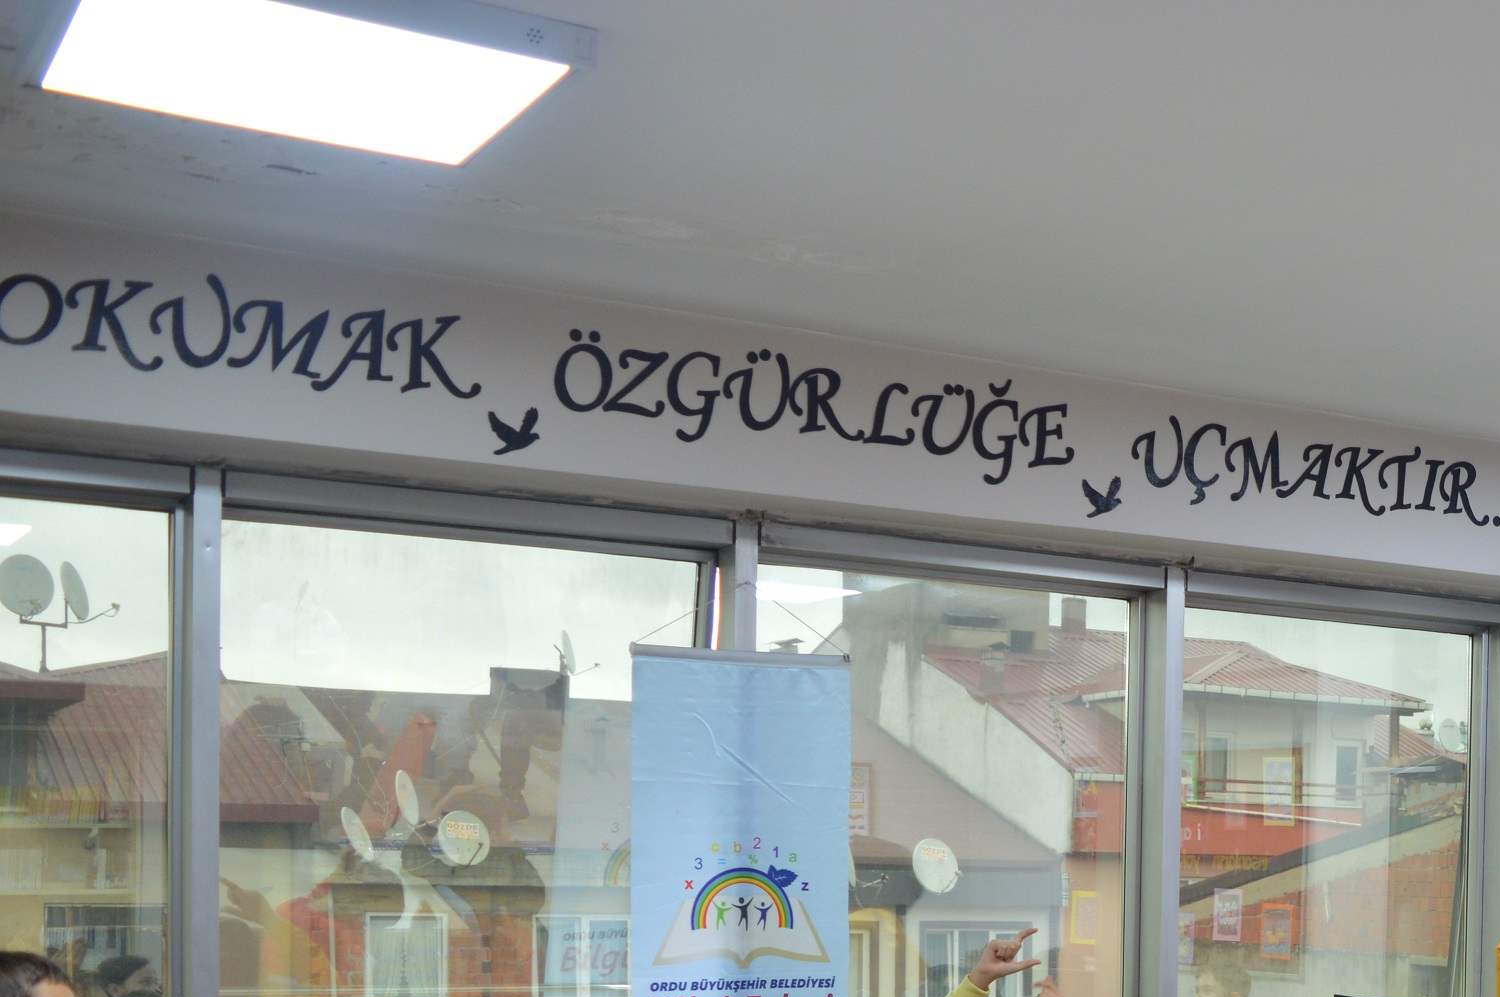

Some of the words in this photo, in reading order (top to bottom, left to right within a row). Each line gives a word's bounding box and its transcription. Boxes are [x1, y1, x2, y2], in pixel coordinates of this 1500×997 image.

[0, 274, 481, 399] OKUMAK
[554, 329, 1075, 485] ÖZGÜRLÜĞE
[694, 857, 703, 870] 3
[752, 837, 761, 849] 2
[772, 846, 779, 858] 1
[788, 853, 798, 863] a
[650, 982, 687, 992] ORDU
[691, 977, 767, 993] BÜYÜKŞEHİR
[770, 976, 836, 989] BELEDİYESİ
